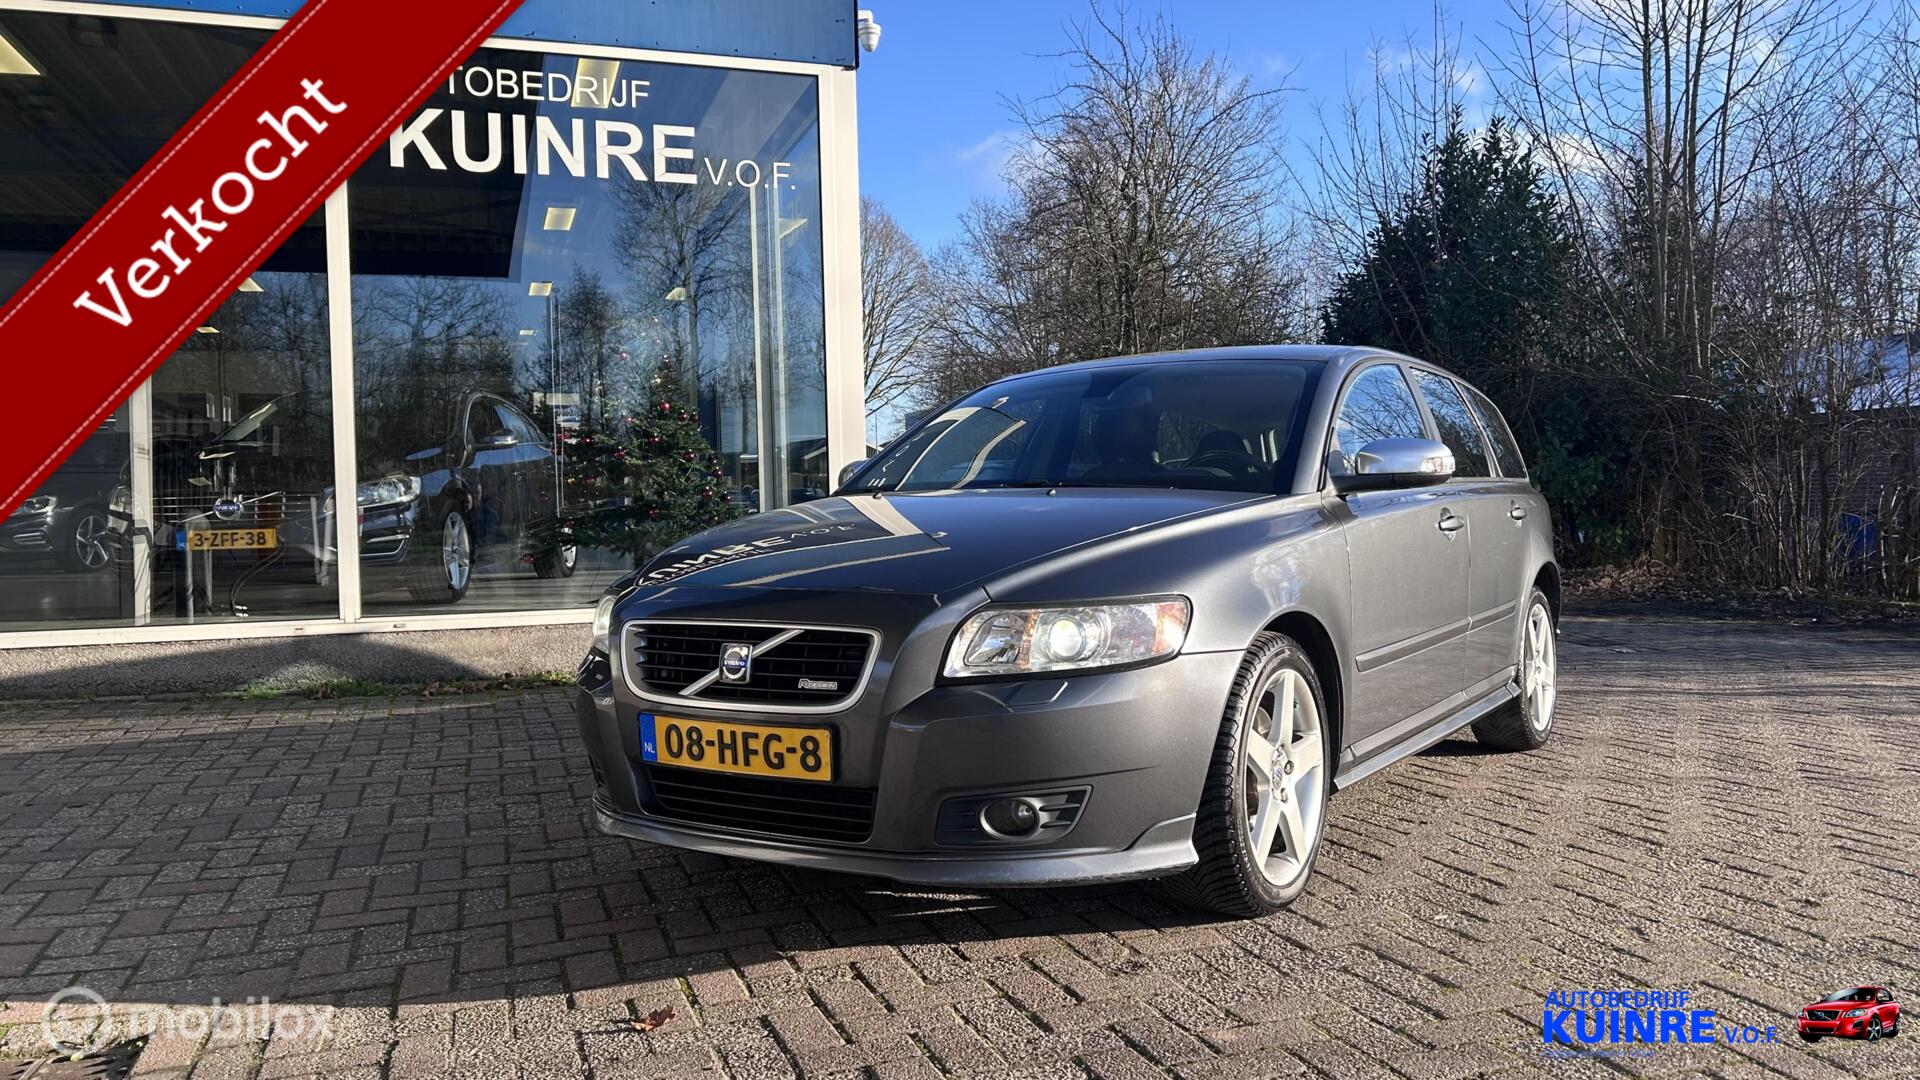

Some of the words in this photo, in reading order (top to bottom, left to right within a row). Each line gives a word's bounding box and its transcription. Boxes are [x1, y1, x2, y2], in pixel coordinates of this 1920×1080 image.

[448, 65, 651, 109] TOBEDRIJF
[389, 107, 698, 185] KUINRE
[703, 158, 797, 191] V.O.F.
[194, 531, 268, 548] 3-ZFF-38
[644, 742, 656, 755] NL
[664, 722, 823, 774] 08-HFG-8
